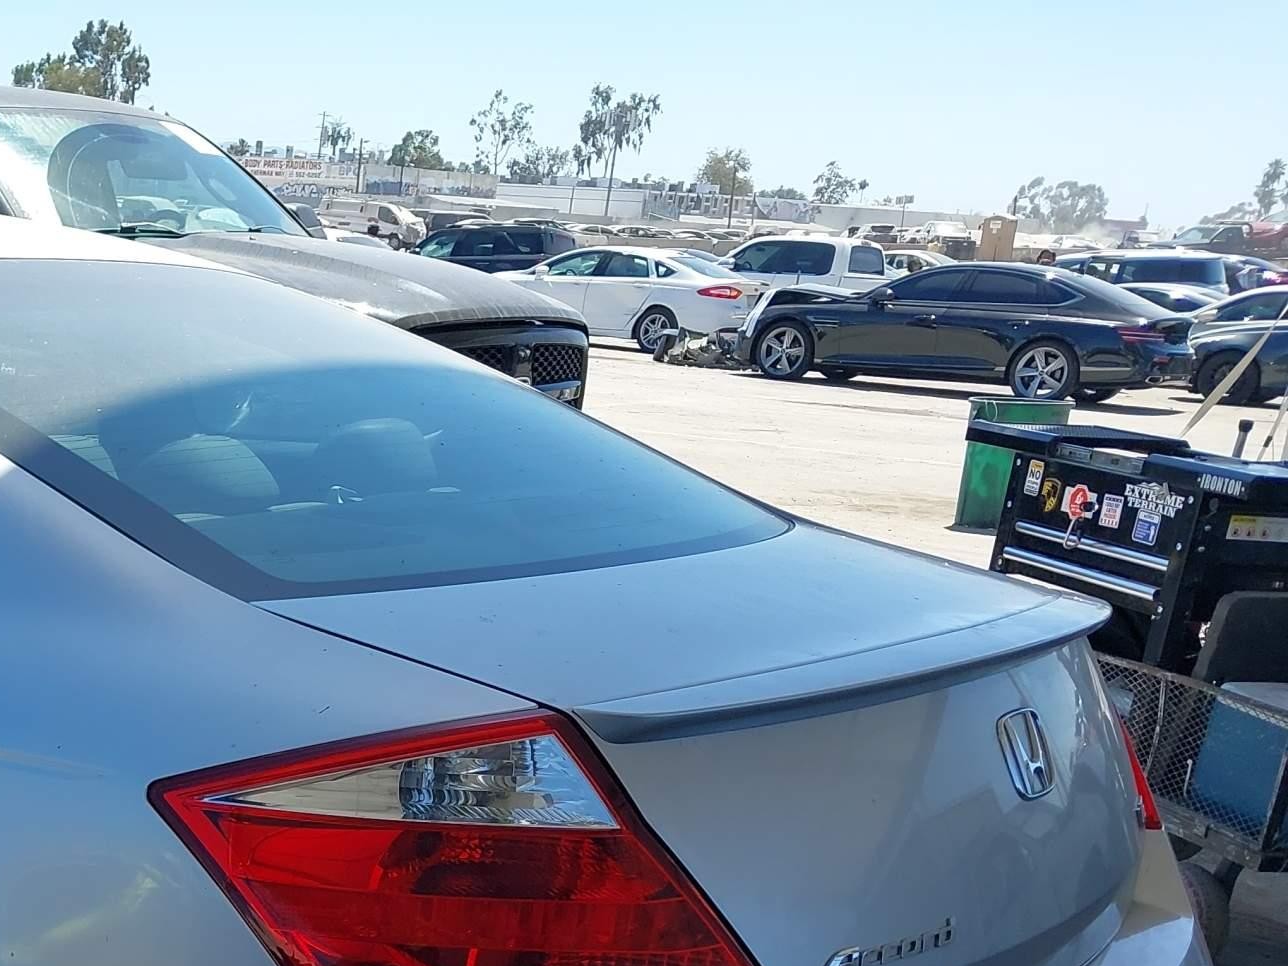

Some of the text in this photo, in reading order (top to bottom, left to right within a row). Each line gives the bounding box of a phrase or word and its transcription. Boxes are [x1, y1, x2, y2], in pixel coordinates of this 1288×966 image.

[1029, 468, 1041, 480] NO
[1199, 473, 1242, 497] IRONTON
[1124, 483, 1186, 509] EXTRME
[1127, 496, 1177, 518] TERRAIN
